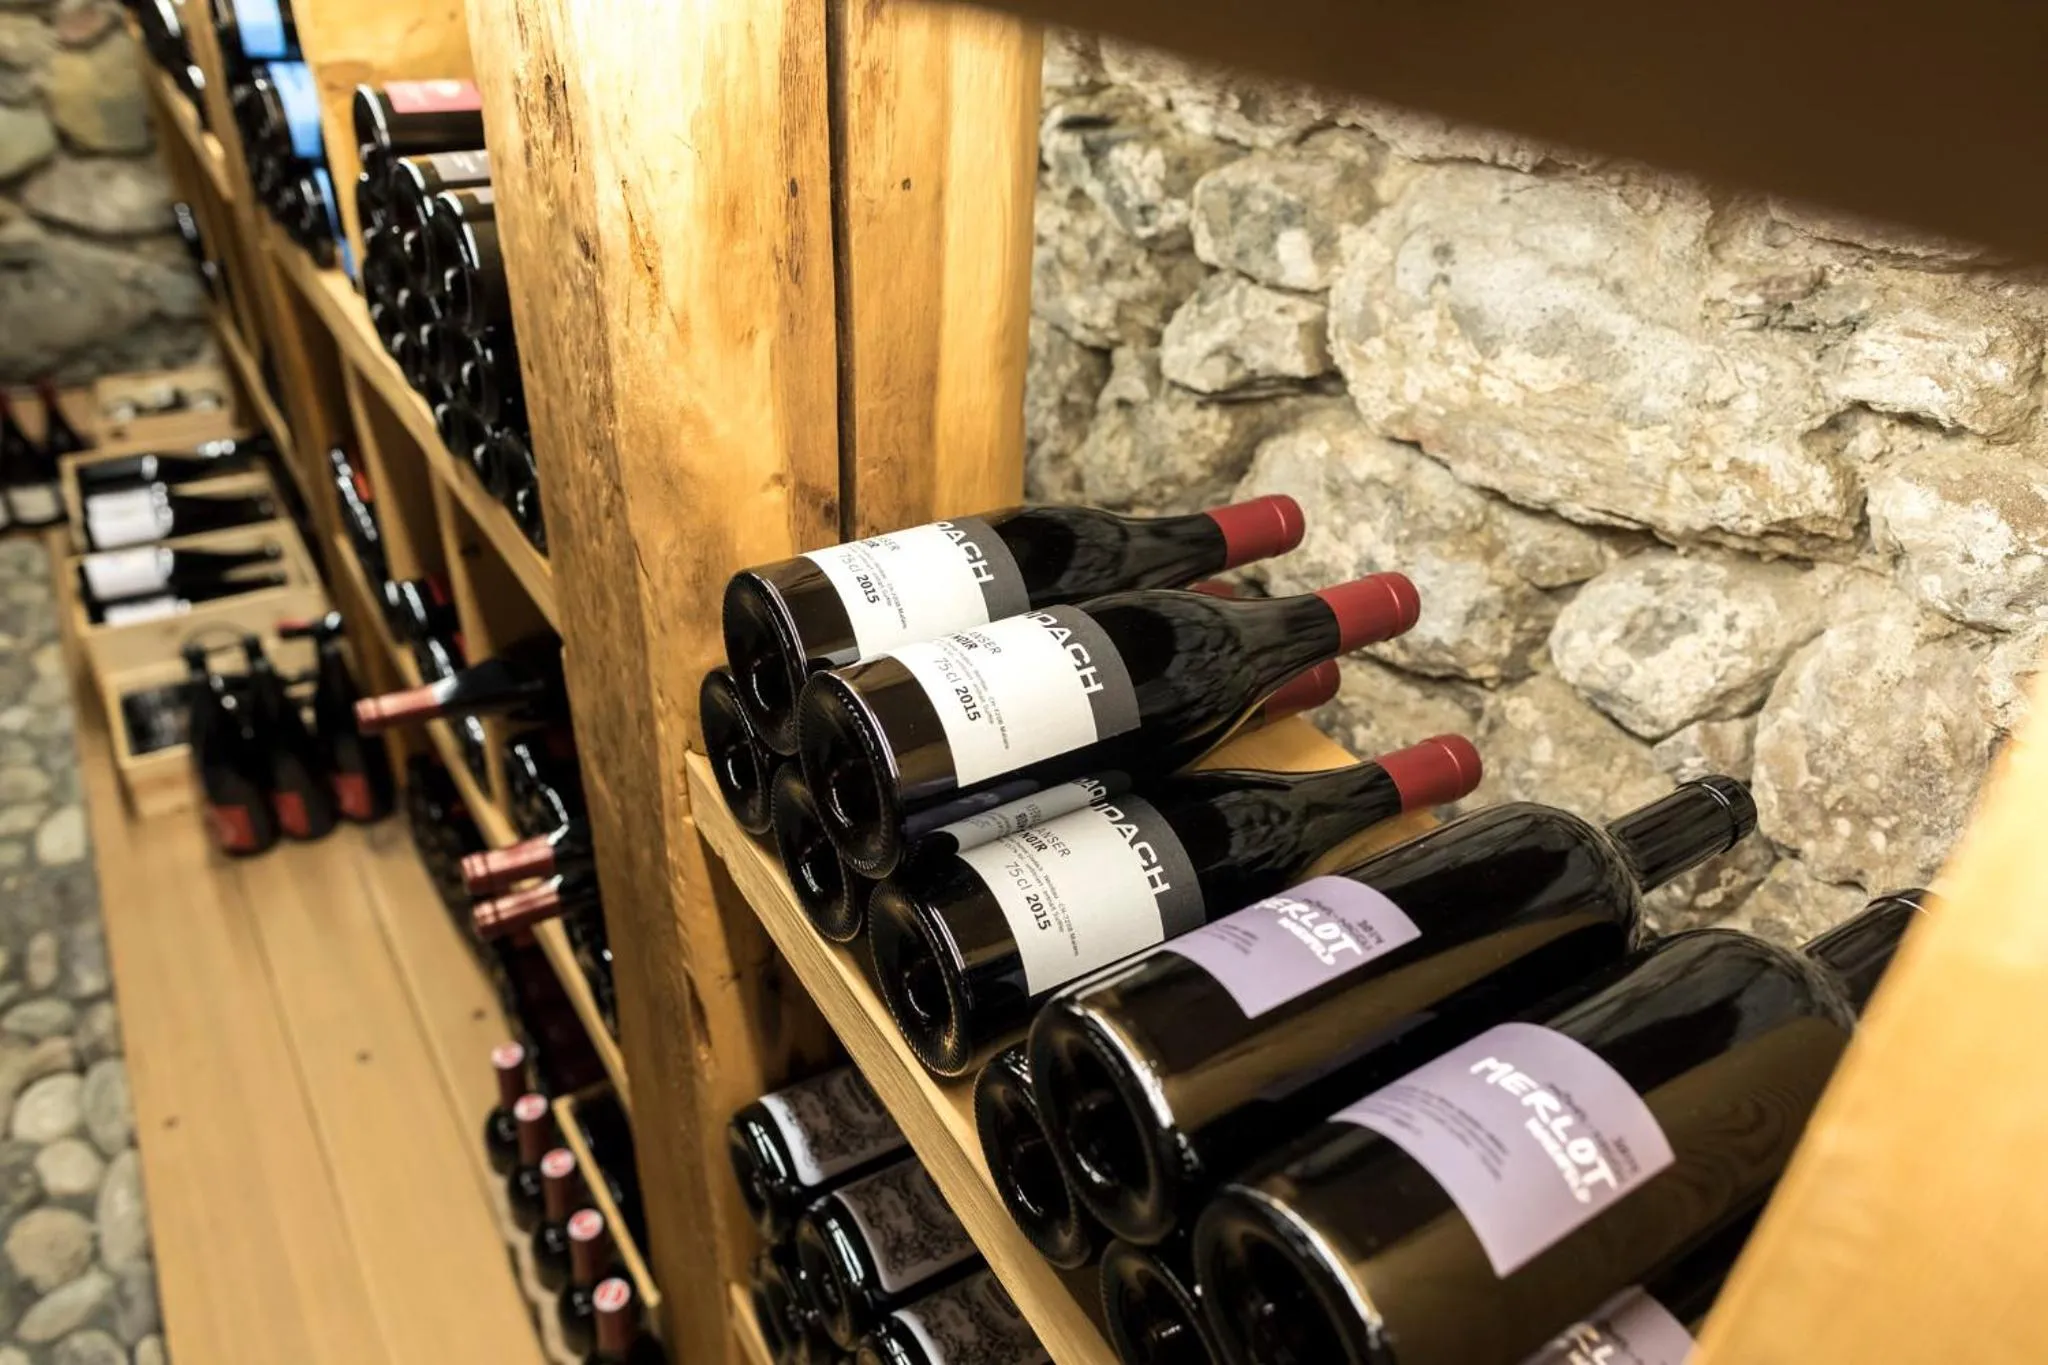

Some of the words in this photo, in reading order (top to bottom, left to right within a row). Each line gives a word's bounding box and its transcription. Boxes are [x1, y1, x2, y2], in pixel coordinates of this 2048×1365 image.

[856, 574, 881, 604] 2015
[955, 685, 982, 722] 2015
[1026, 893, 1053, 931] 2015
[1470, 1056, 1618, 1191] MERLOT
